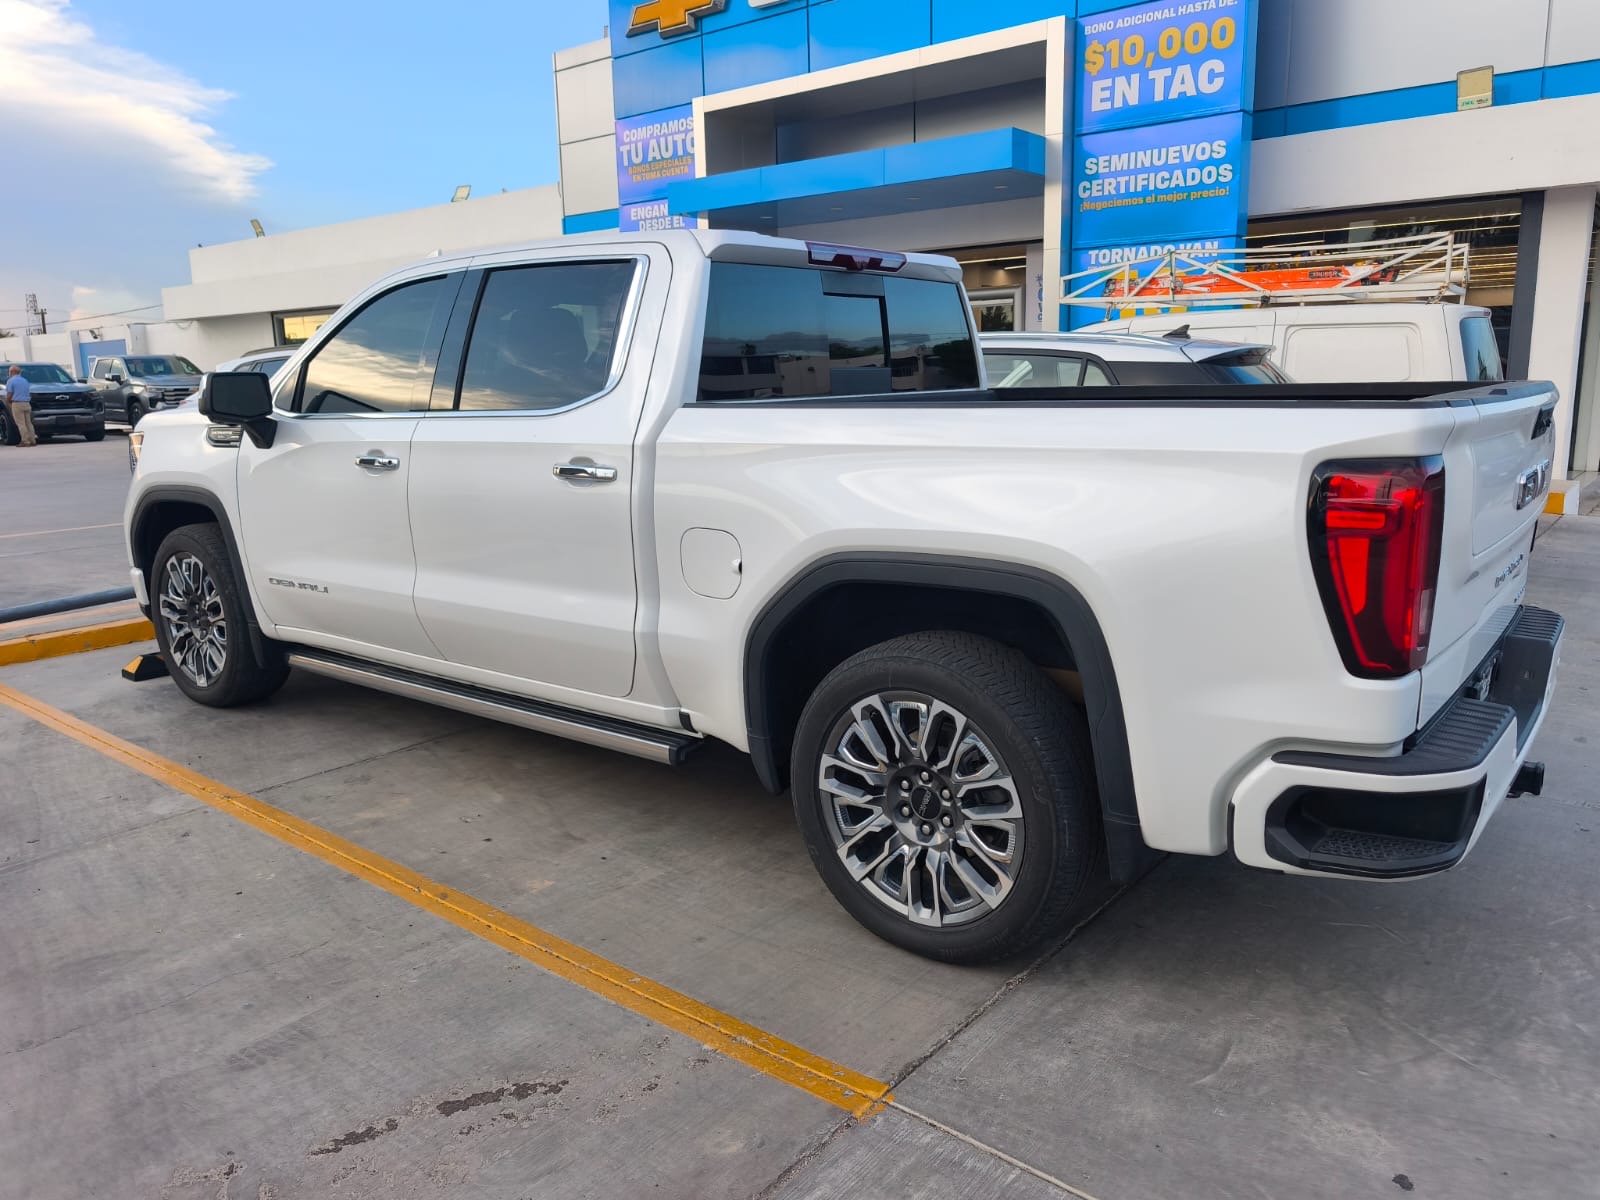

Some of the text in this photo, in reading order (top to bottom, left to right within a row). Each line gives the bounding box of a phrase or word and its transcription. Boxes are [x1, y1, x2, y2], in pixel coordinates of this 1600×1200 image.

[1085, 20, 1114, 36] BONO
[1116, 8, 1176, 29] ADICIONAL
[1178, 0, 1217, 16] HASTA
[1085, 16, 1236, 77] $10,000
[1091, 58, 1225, 113] EN TAC
[623, 117, 694, 142] COMPRAMOS
[620, 132, 695, 167] TU AUTO
[1085, 139, 1227, 175] SEMINUEVOS
[1078, 163, 1233, 198] CERTIFICADOS
[1146, 194, 1155, 203] el
[1157, 192, 1188, 203] mejor
[1190, 186, 1230, 201] precio!
[630, 203, 668, 221] ENGAN
[640, 215, 686, 232] DESDE EL
[1088, 241, 1219, 265] TORNADO VAN
